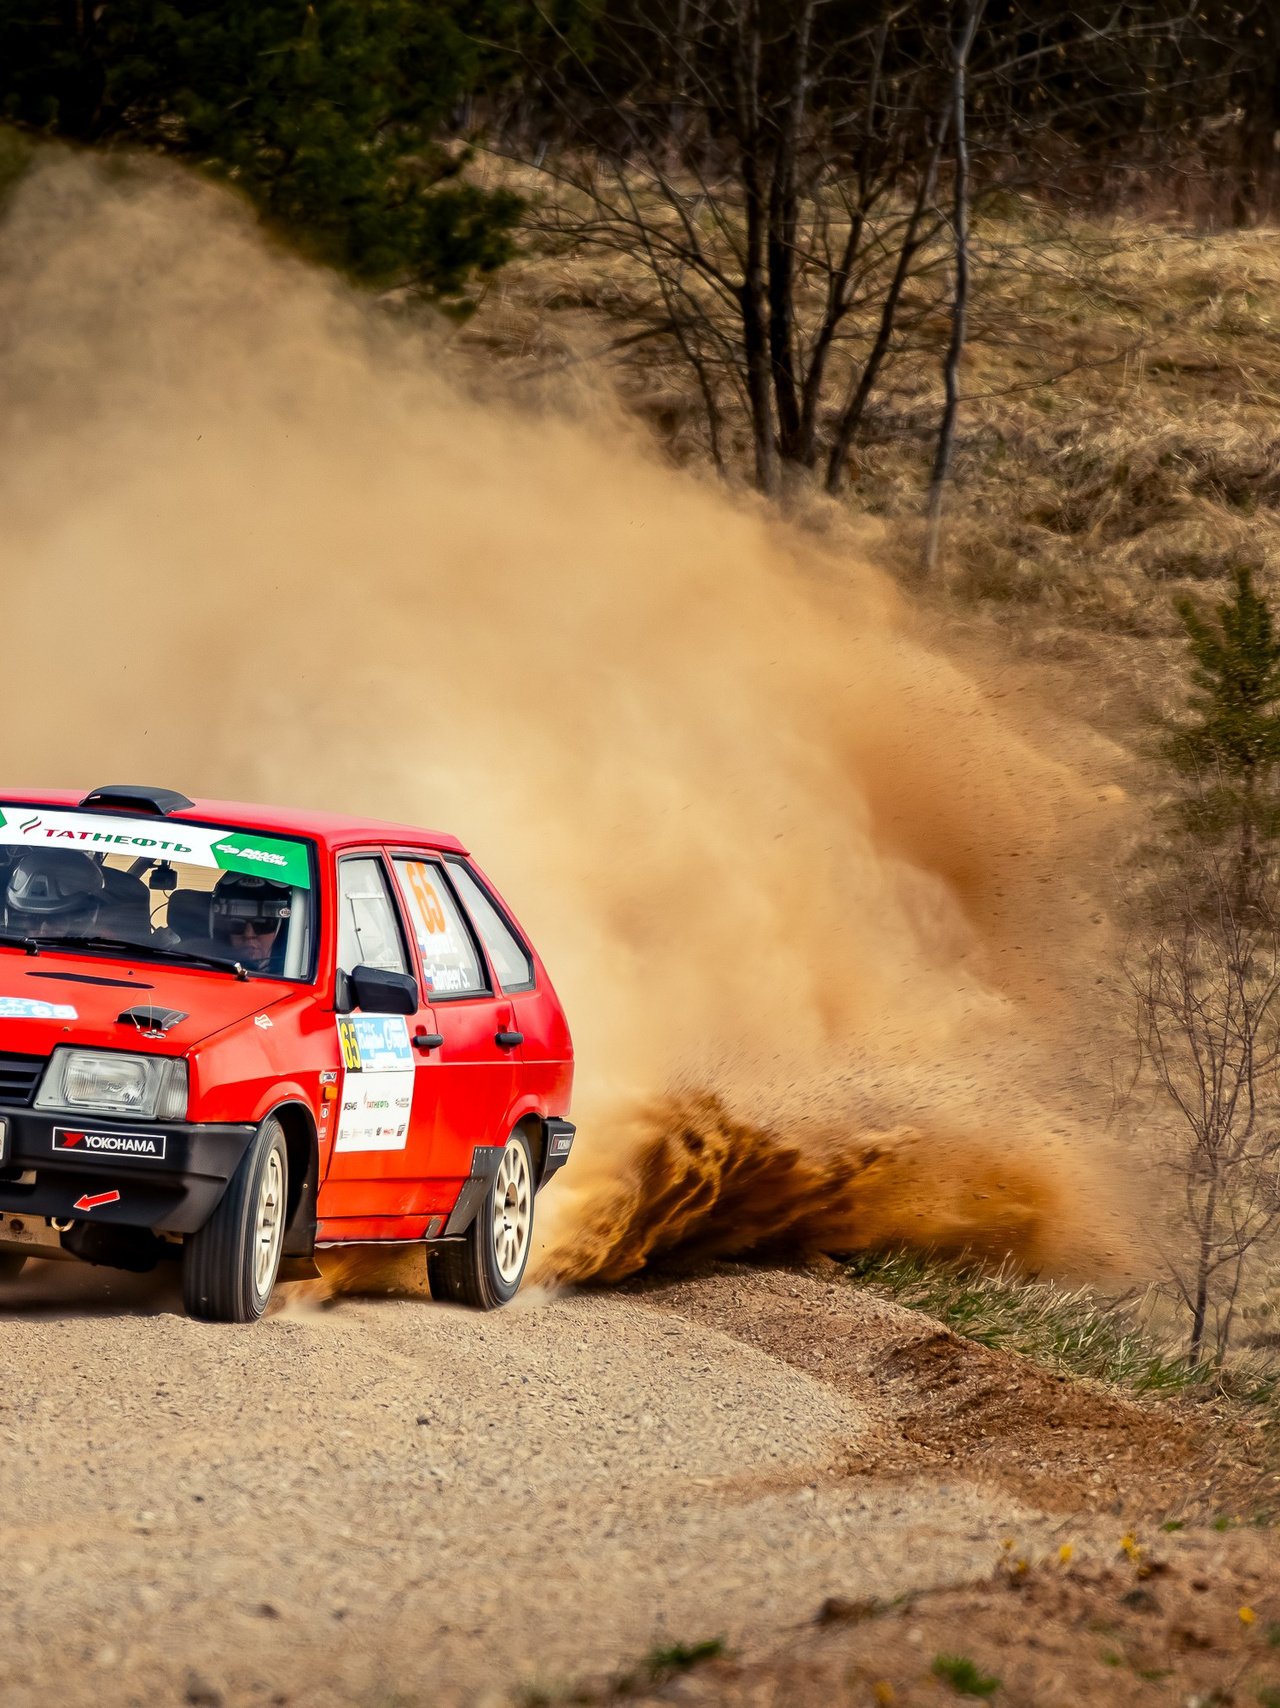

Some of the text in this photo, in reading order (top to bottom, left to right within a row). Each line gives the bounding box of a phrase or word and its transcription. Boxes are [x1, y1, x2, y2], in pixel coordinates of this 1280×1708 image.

[43, 828, 193, 853] ТАТНЕФТЬ
[405, 861, 446, 935] 65
[340, 1022, 362, 1070] 65
[84, 1135, 157, 1153] YOKOHAMA
